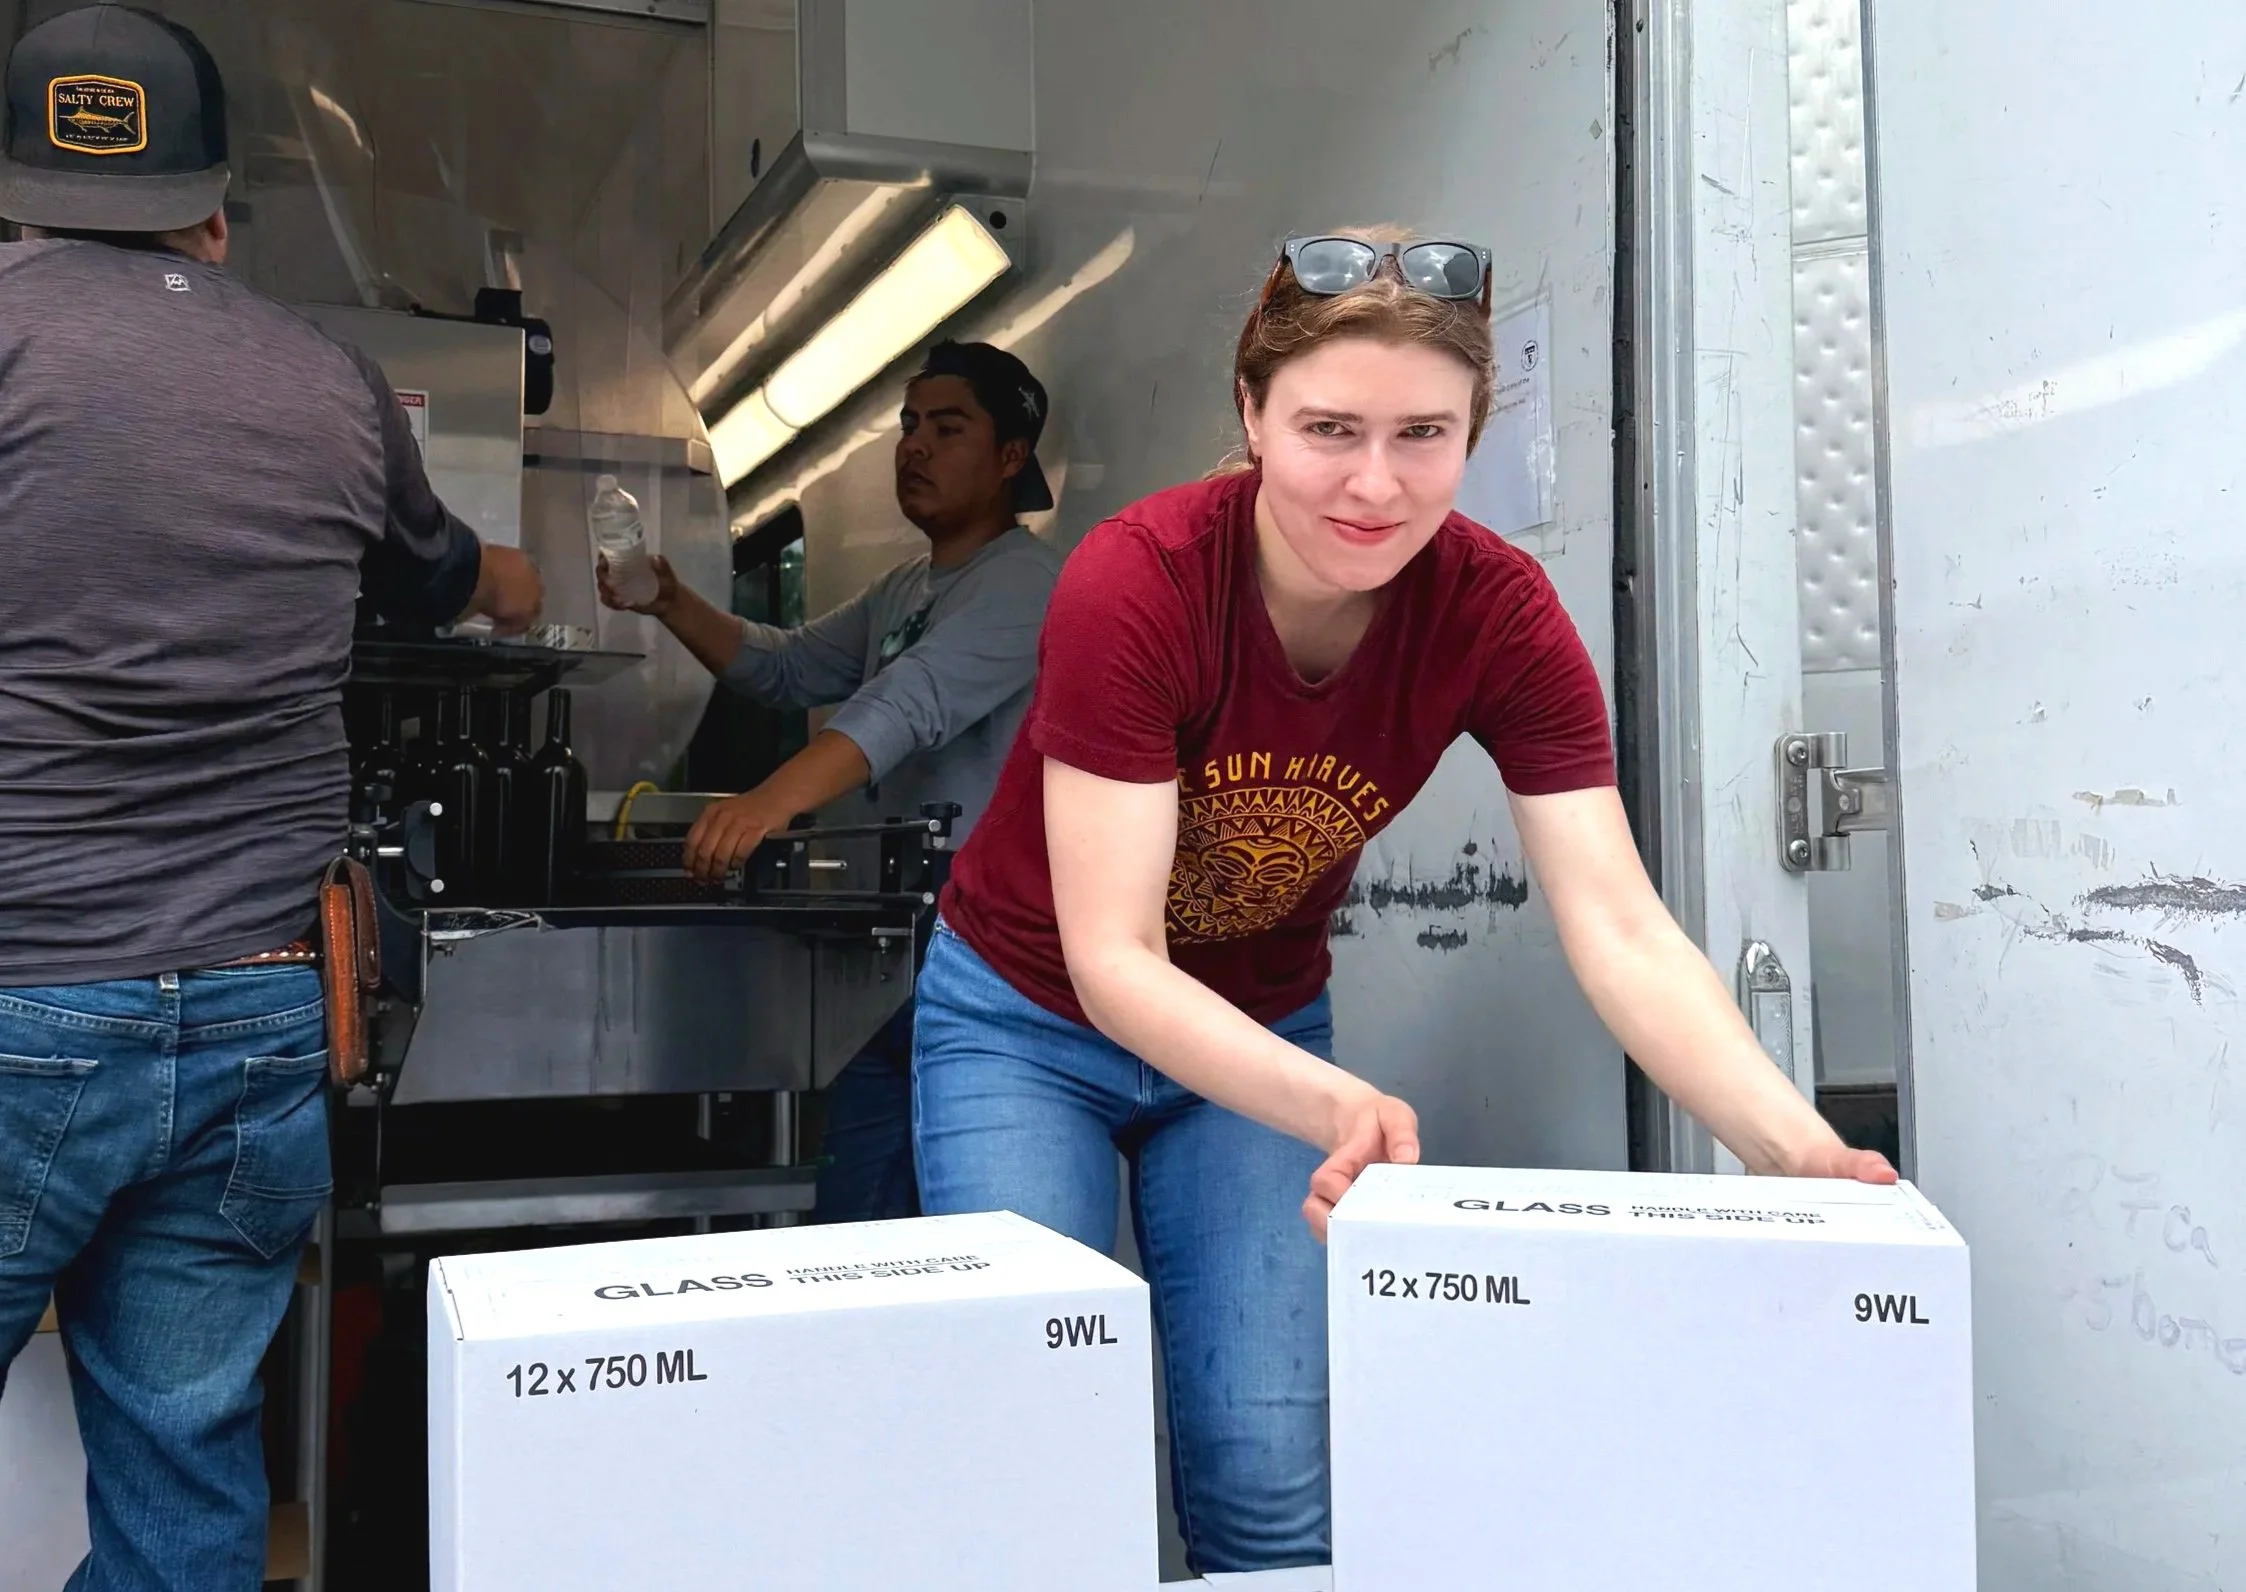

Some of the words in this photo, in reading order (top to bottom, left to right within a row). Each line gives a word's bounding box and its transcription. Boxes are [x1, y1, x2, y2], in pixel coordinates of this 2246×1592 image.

[58, 93, 93, 105] SALTY
[99, 95, 135, 108] CREW
[1204, 751, 1271, 789] SUN
[1453, 1199, 1611, 1216] GLASS
[1631, 1204, 1708, 1213] HANDLE
[1713, 1207, 1763, 1215] WITH
[1767, 1210, 1822, 1218] CARE
[1628, 1211, 1696, 1220] THIS
[1704, 1214, 1776, 1223] SIDE
[1785, 1217, 1827, 1225] UP
[594, 1273, 774, 1300] GLASS
[786, 1264, 866, 1275] HANDLE
[870, 1258, 922, 1268] WITH
[925, 1255, 980, 1264] CARE
[788, 1273, 864, 1285] THIS
[870, 1266, 945, 1278] SIDE
[950, 1262, 991, 1273] UP
[1361, 1268, 1397, 1297] 12
[1402, 1276, 1419, 1299] x
[1425, 1271, 1478, 1302] 750
[1485, 1275, 1531, 1305] ML
[1854, 1293, 1930, 1325] 9WL
[1045, 1314, 1118, 1349] 9WL
[506, 1362, 549, 1398] 12
[556, 1367, 577, 1395] x
[585, 1353, 647, 1391] 750
[656, 1348, 708, 1385] ML
